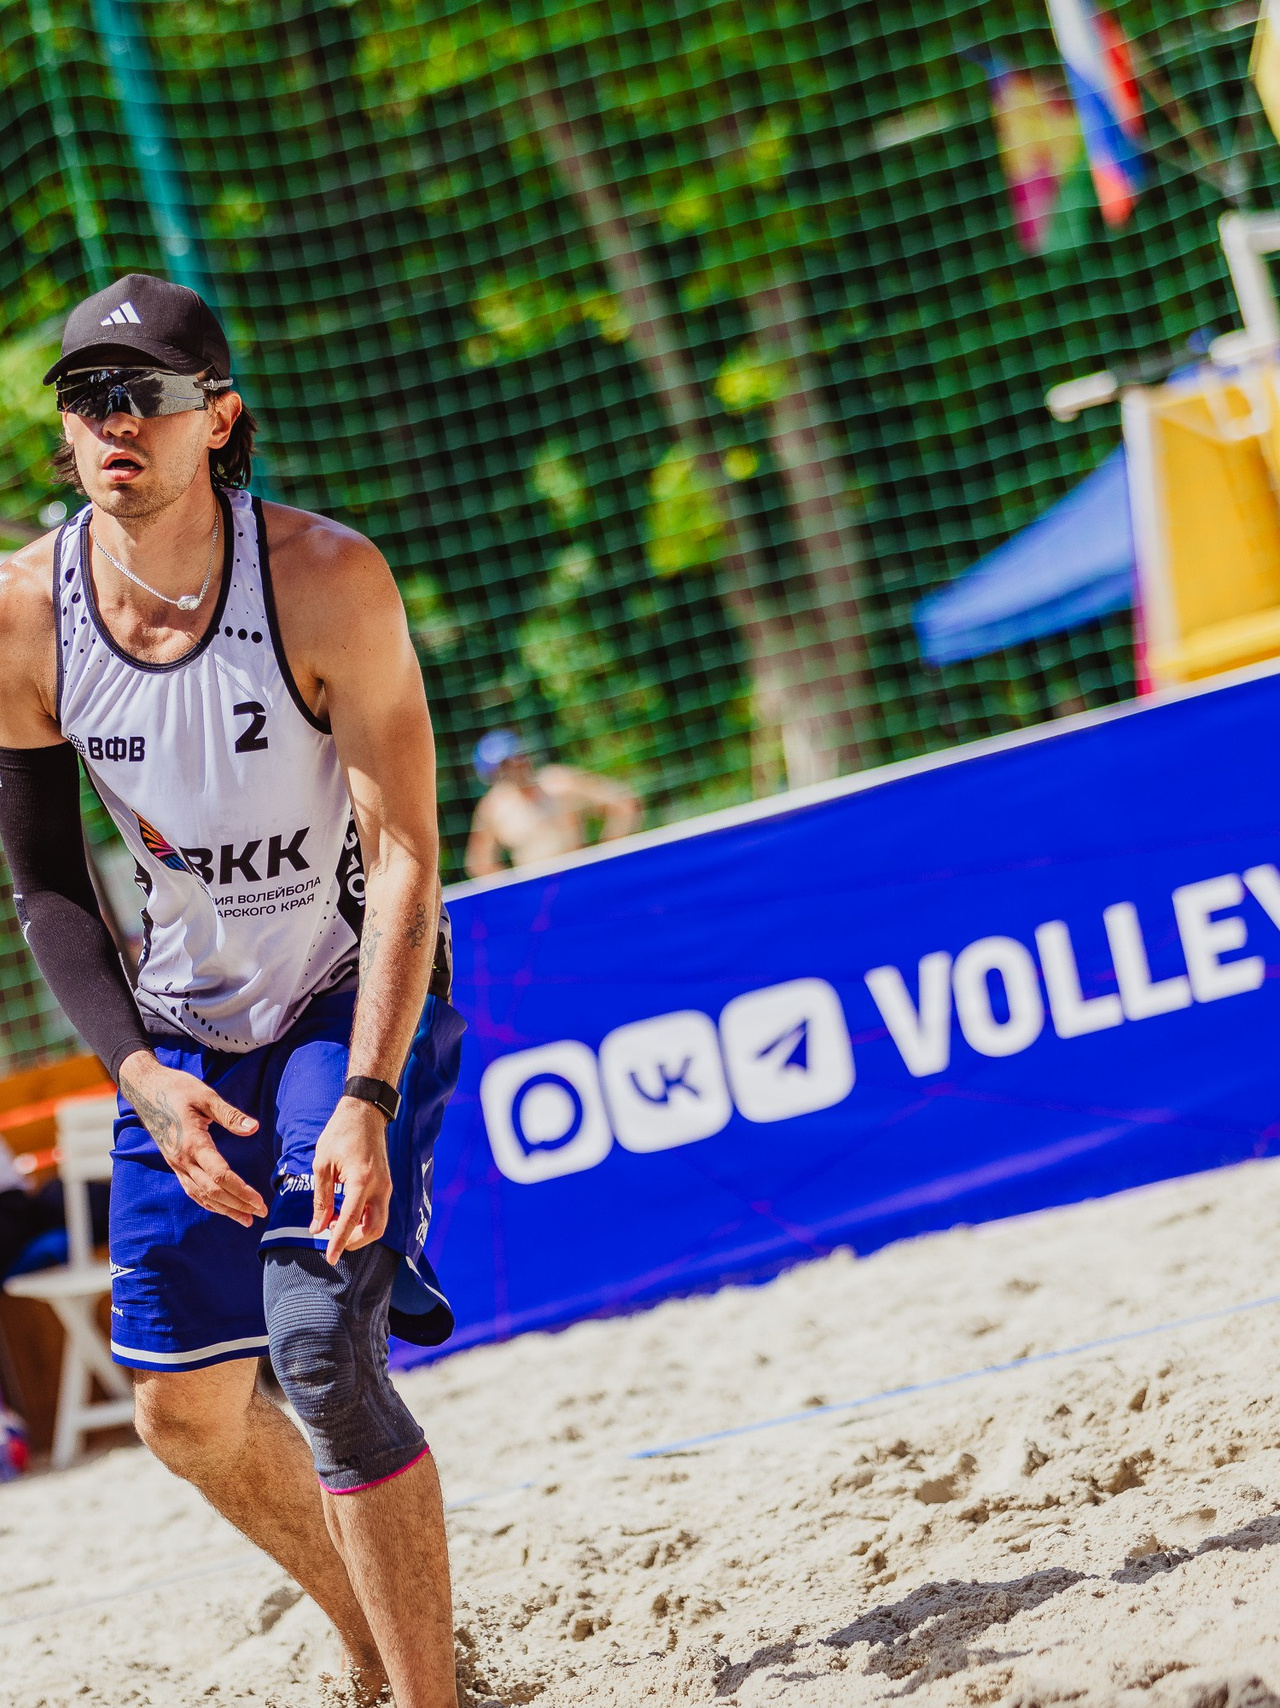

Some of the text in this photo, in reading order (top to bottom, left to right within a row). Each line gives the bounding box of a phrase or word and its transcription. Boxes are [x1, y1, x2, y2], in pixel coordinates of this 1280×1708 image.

[232, 701, 269, 754] 2
[87, 736, 146, 762] ВФВ
[212, 876, 321, 906] ИЯ ВОЛЕЙБОЛА
[281, 893, 315, 912] КРАЯ
